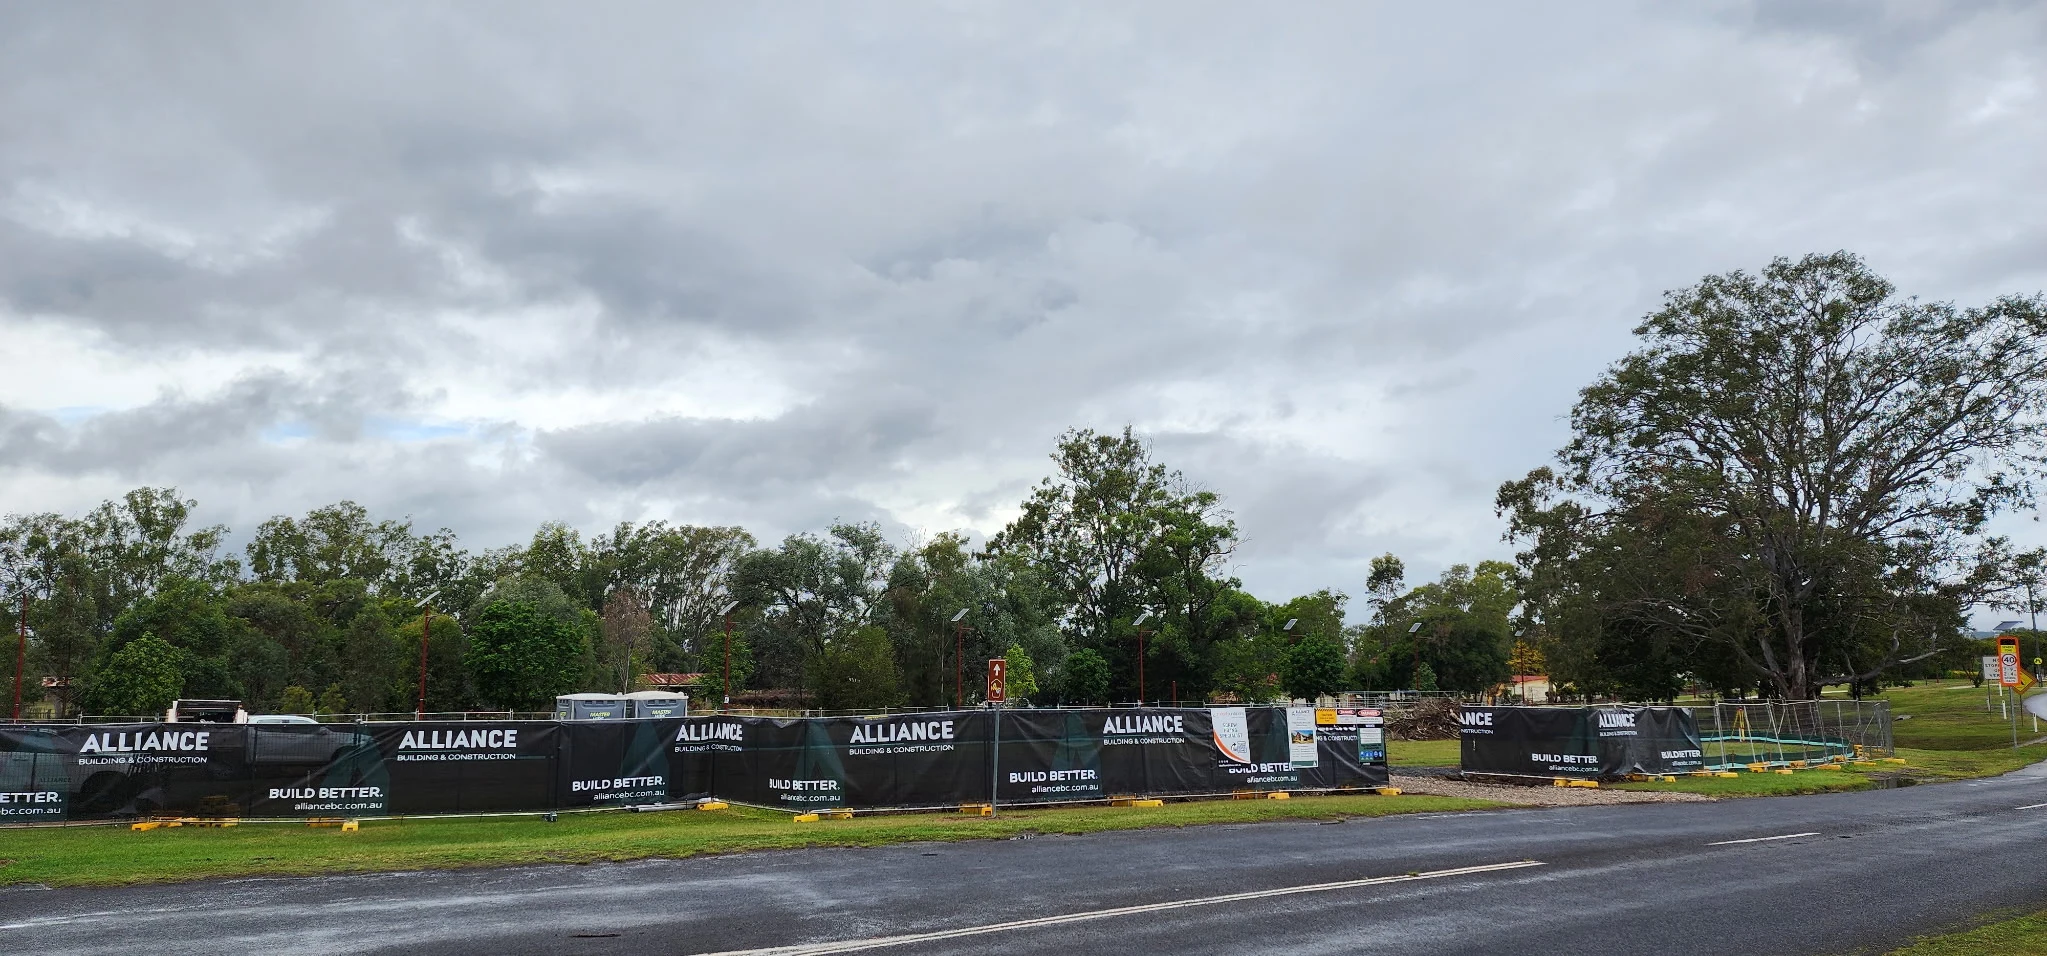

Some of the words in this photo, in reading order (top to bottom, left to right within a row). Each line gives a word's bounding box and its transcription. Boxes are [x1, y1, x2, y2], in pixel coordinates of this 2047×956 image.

[1103, 715, 1184, 734] ALLIANCE
[1599, 713, 1636, 728] ALLIANCE
[675, 723, 743, 741] ALLIANCE
[849, 720, 954, 743] ALLIANCE
[80, 731, 210, 752] ALLIANCE
[398, 730, 518, 749] ALLIANCE
[893, 744, 954, 753] CONSTRUCTION
[1531, 753, 1562, 763] BUILD
[1009, 771, 1047, 783] BUILD
[1049, 769, 1099, 781] BETTER.
[572, 779, 611, 791] BUILD
[613, 776, 666, 789] BETTER.
[769, 778, 791, 789] BUILD
[792, 780, 841, 791] BETTER.
[1031, 784, 1099, 793] alliancebc.com.au
[269, 787, 316, 799] BUILD
[319, 786, 384, 798] BETTER.
[593, 789, 665, 800] alliancebc.com.au
[0, 807, 61, 815] bc.com.au
[294, 802, 382, 810] alliancebc.com.au
